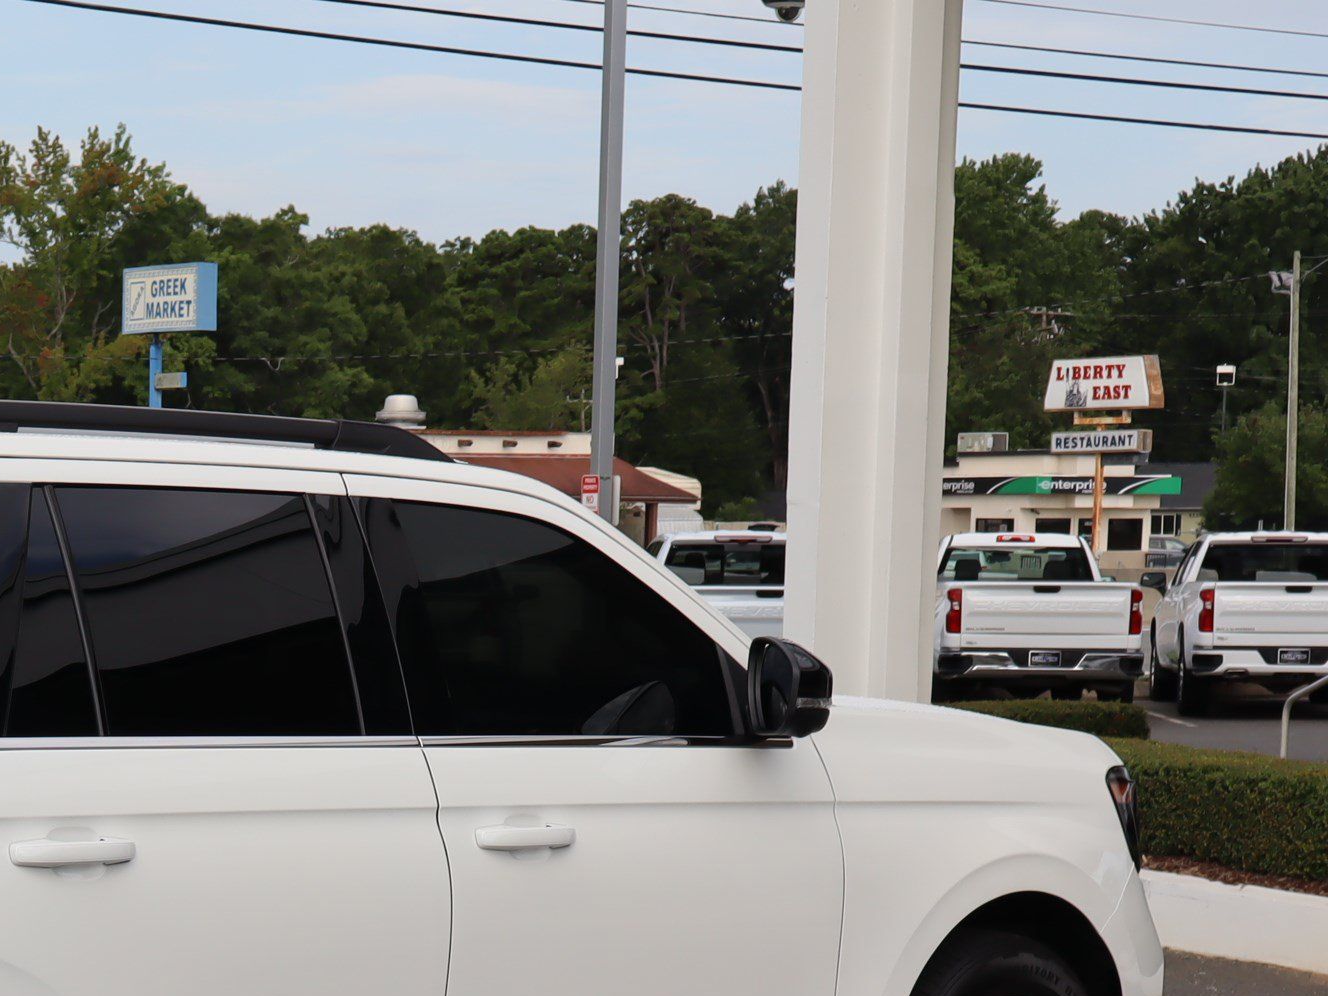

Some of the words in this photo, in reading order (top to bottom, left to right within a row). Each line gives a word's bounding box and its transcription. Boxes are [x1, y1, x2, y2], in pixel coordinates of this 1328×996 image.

[150, 277, 188, 298] GREEK
[145, 300, 192, 320] MARKET
[1055, 364, 1127, 382] LIBERTY
[1092, 384, 1133, 401] EAST
[1055, 434, 1134, 450] RESTAURANT
[943, 480, 975, 492] erprise
[1038, 479, 1107, 492] enterpri
